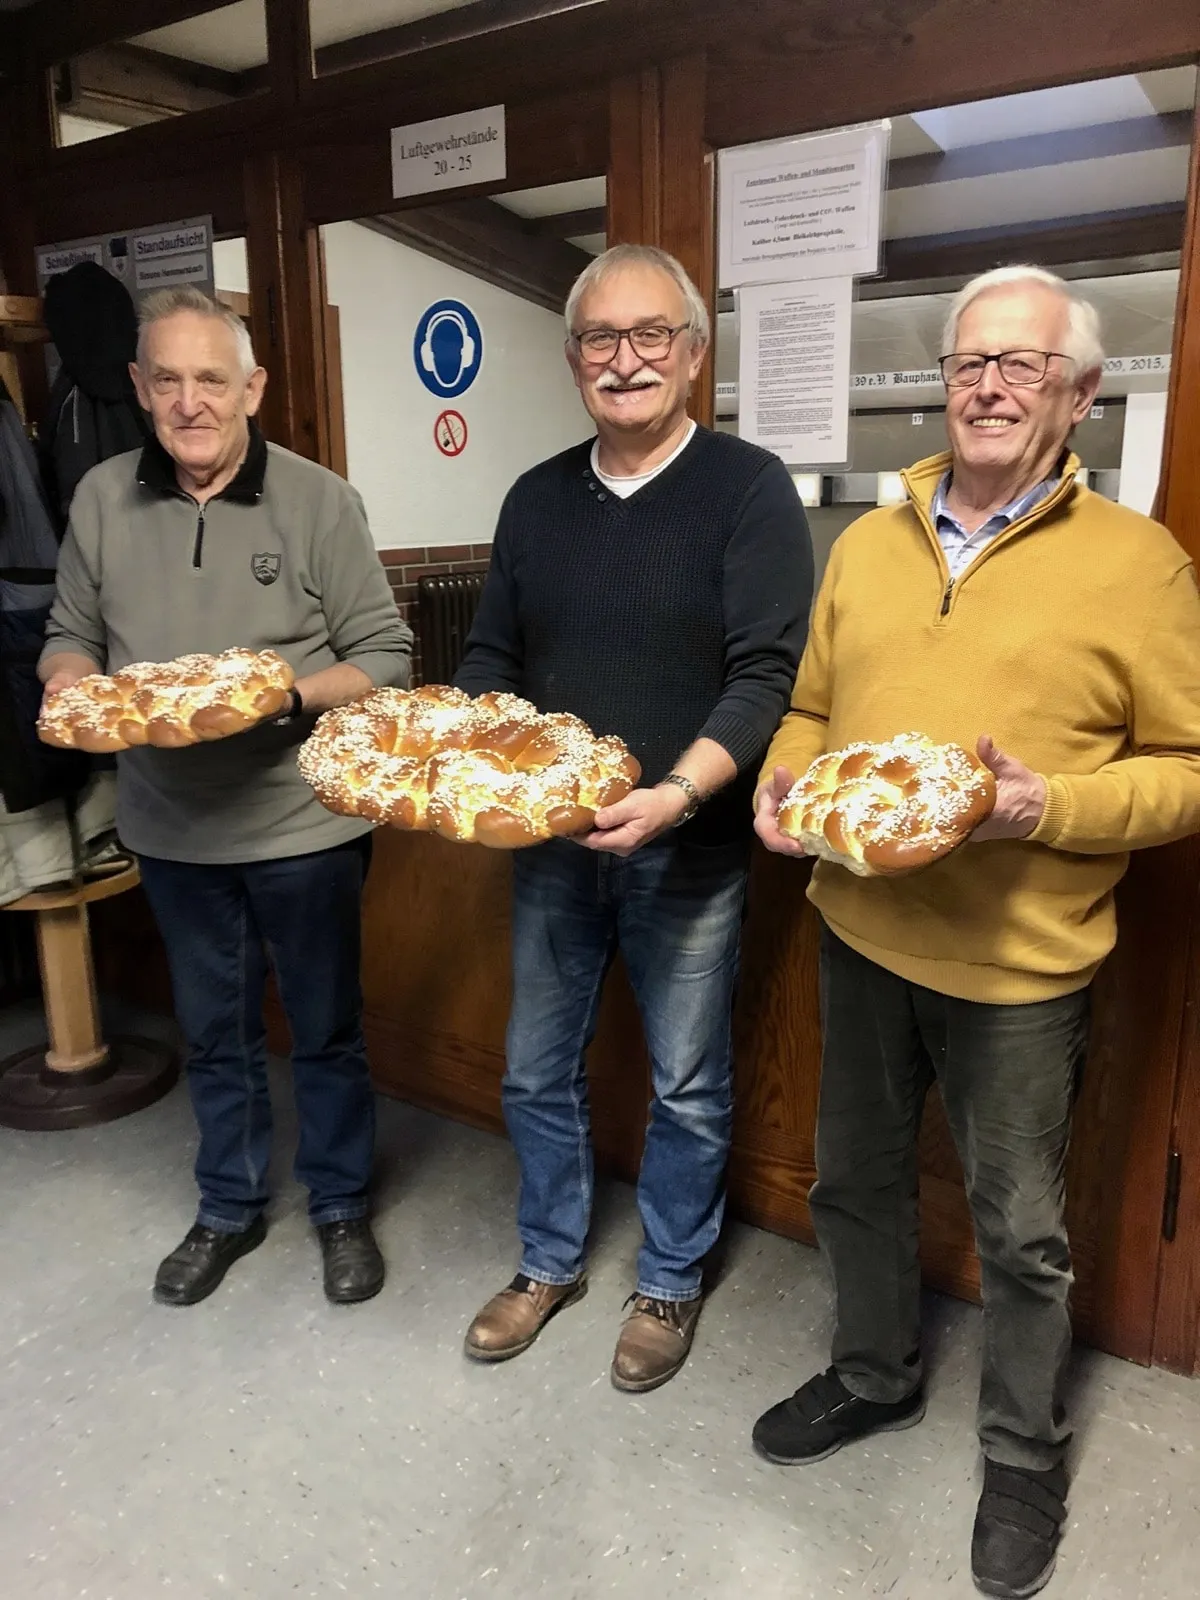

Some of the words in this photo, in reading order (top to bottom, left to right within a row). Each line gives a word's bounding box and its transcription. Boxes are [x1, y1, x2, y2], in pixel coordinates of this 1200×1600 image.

[400, 126, 498, 160] Luftgewehrstände
[433, 159, 448, 176] 20
[458, 154, 473, 171] 25
[808, 210, 819, 218] und
[835, 204, 856, 213] Waffen
[137, 232, 204, 254] Standaufsicht
[913, 415, 922, 423] 17
